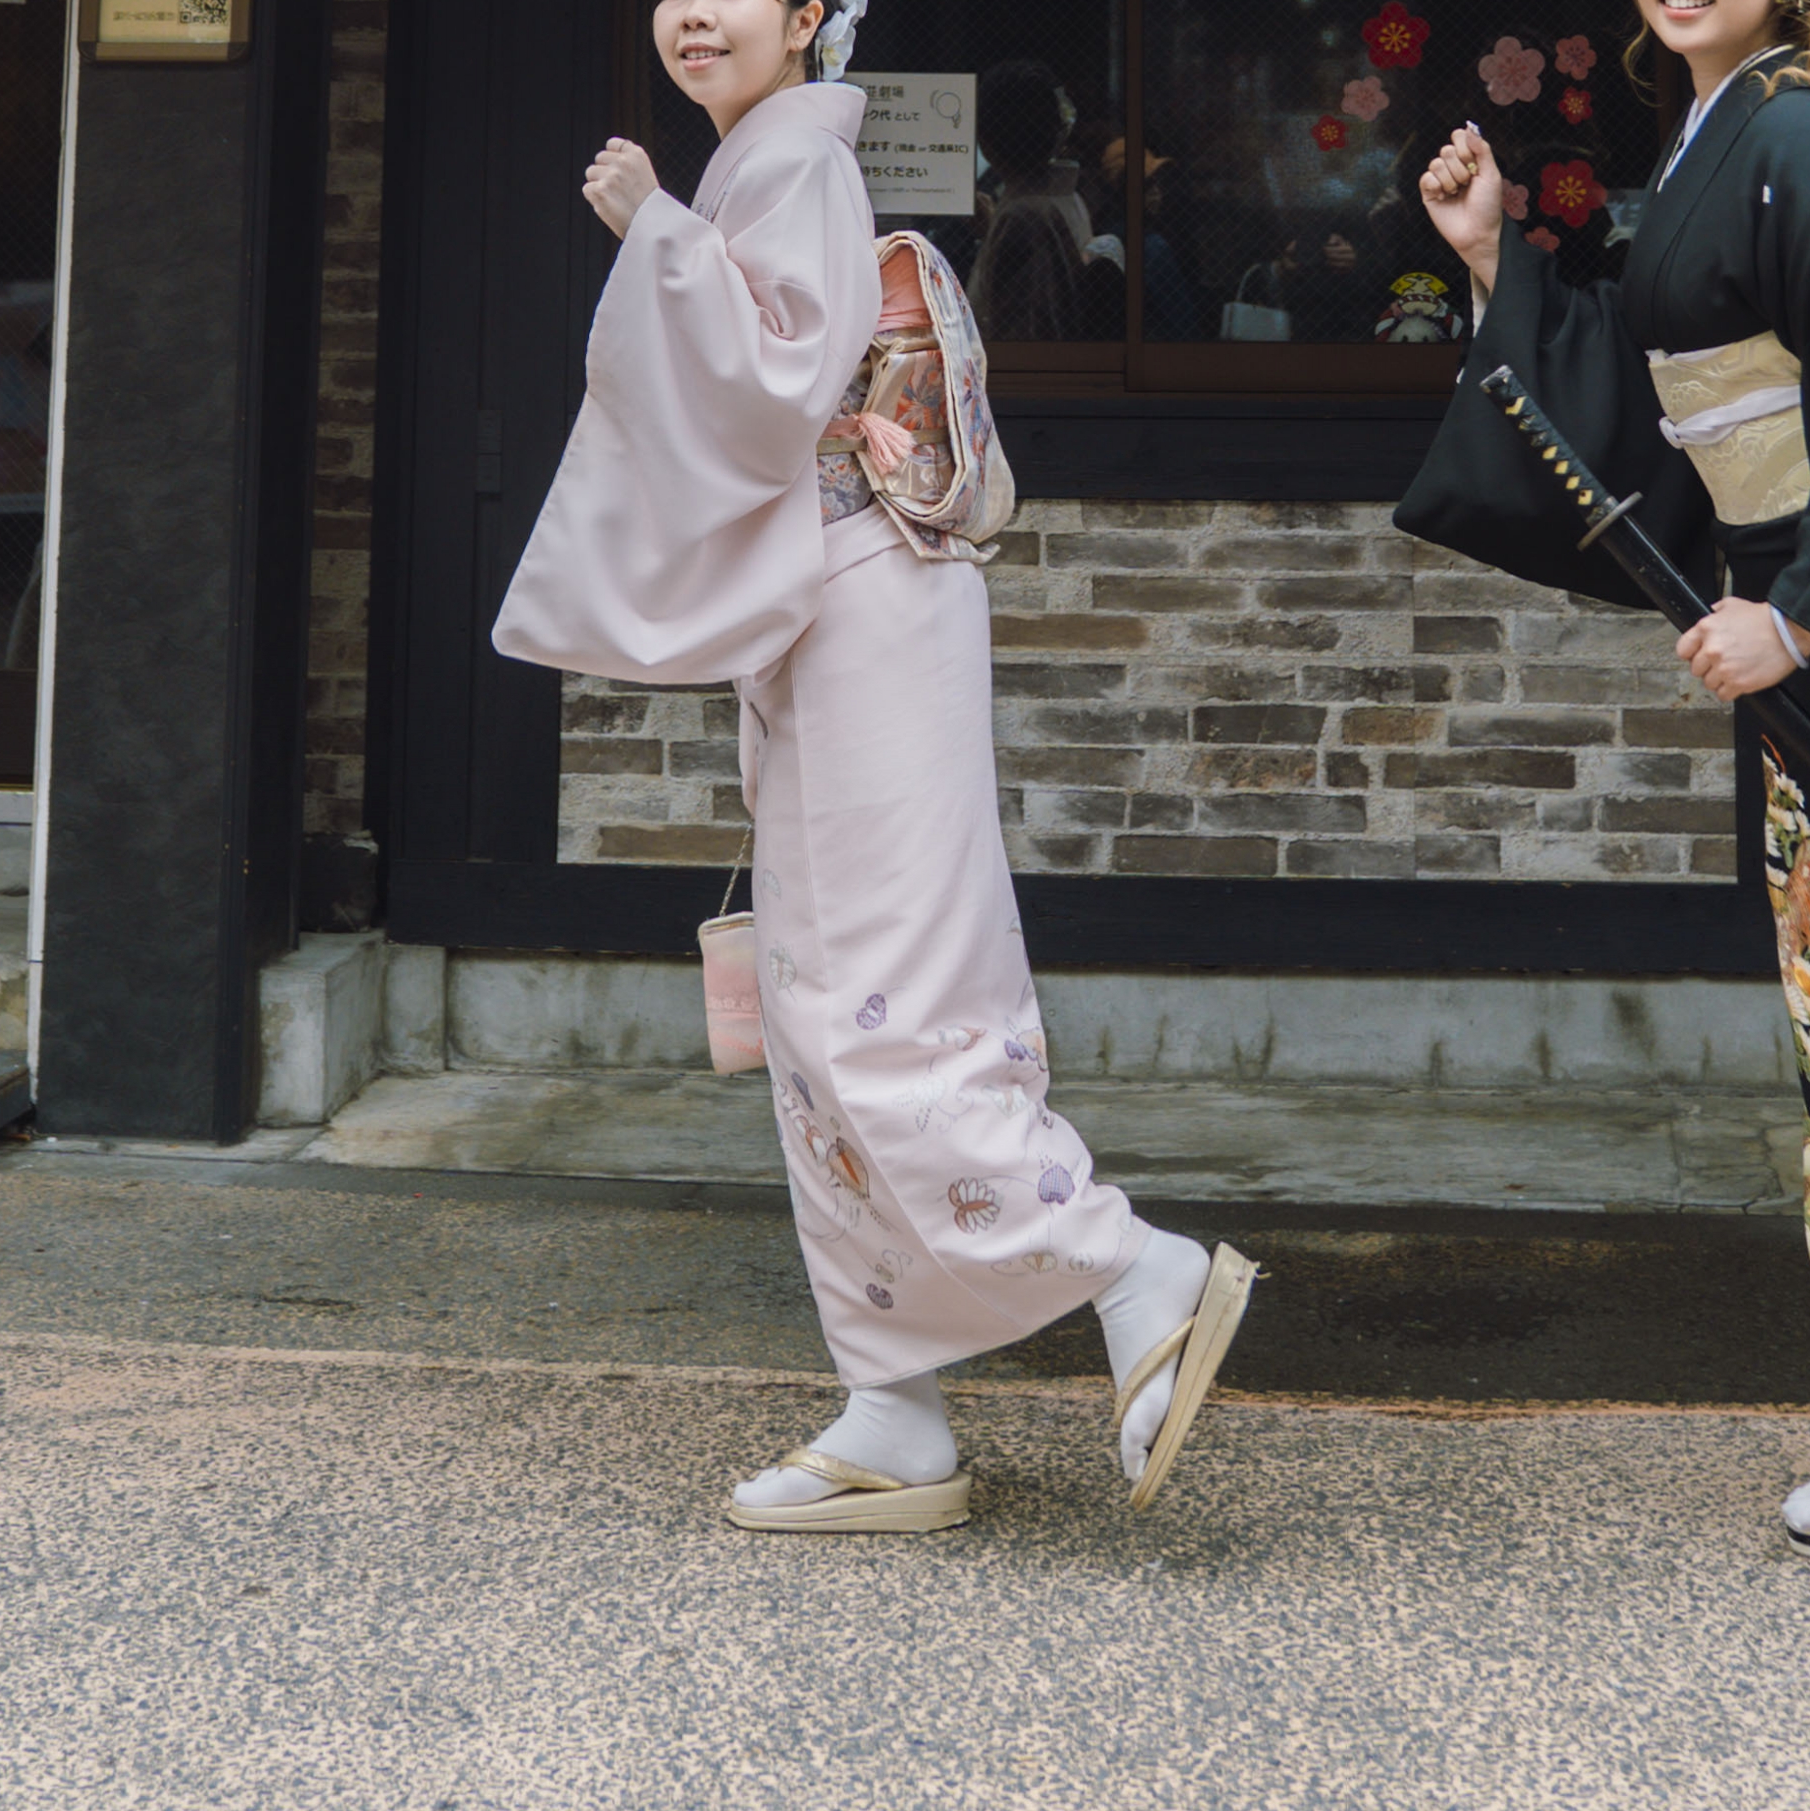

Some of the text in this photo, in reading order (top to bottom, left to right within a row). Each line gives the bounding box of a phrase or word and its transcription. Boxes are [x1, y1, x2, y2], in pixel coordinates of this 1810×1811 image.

[859, 85, 905, 98] 花劇場
[894, 112, 921, 121] として
[854, 140, 891, 153] きます
